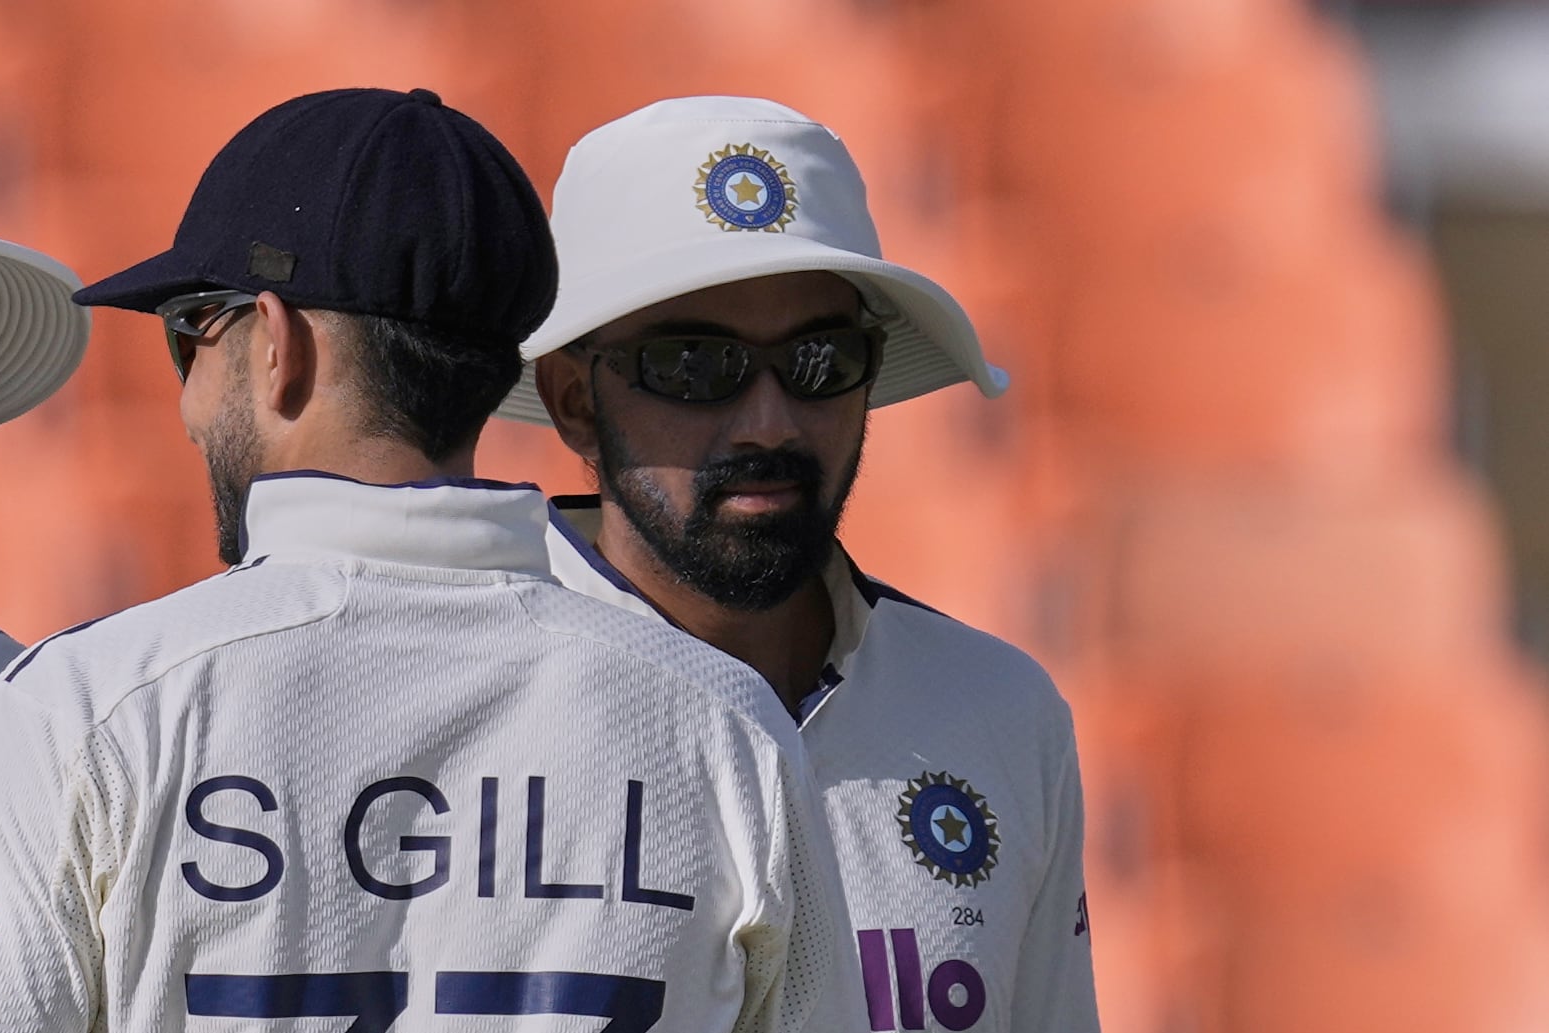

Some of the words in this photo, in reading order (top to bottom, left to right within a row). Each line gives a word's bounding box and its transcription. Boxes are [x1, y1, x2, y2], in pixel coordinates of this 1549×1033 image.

[181, 775, 284, 901] S
[345, 776, 696, 911] GILL
[951, 906, 985, 927] 284
[856, 928, 987, 1032] llo
